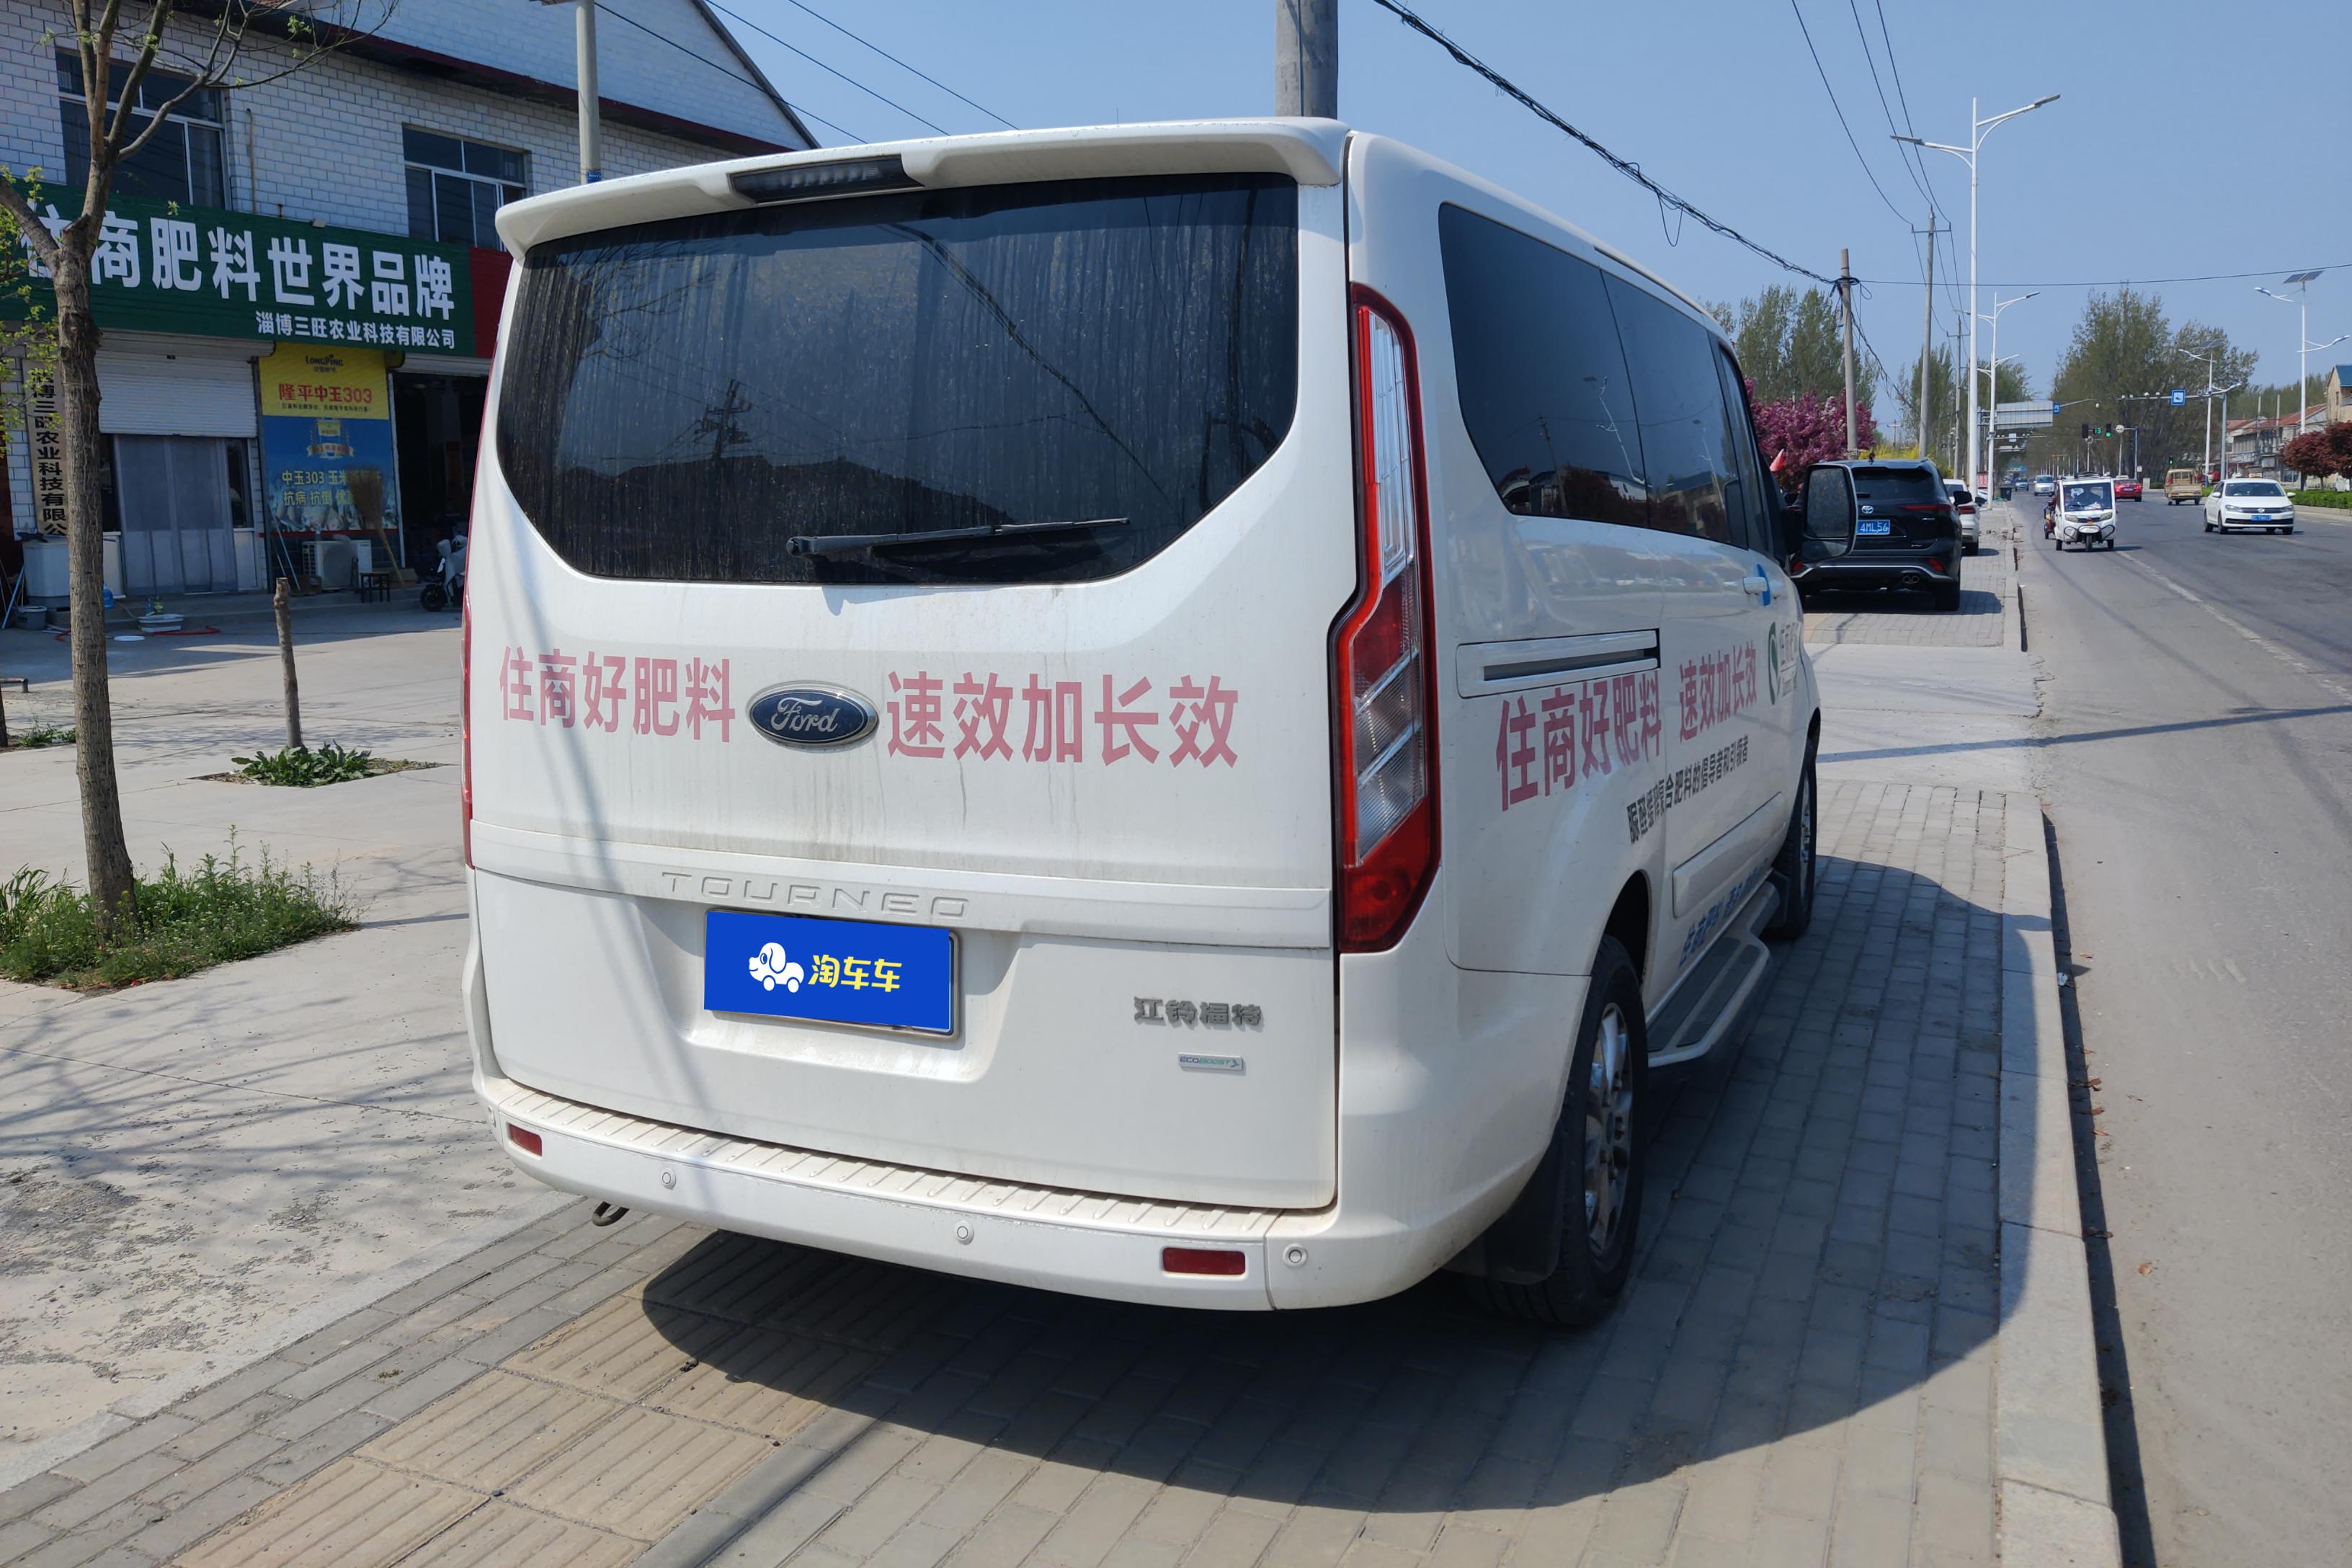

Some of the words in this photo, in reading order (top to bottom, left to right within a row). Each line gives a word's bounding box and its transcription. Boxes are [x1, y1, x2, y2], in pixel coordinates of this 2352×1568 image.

[255, 310, 455, 349] 淄博三旺农业科技有限公司
[282, 470, 325, 486] 中玉303
[499, 646, 736, 743] 住商好肥料
[770, 697, 839, 733] Ford
[886, 670, 1239, 768] 速效加长效
[1496, 668, 1662, 812] 住商好肥料
[1679, 641, 1757, 744] 速效加长效
[662, 870, 969, 920] TOURNEO
[1133, 996, 1262, 1027] 江铃福特
